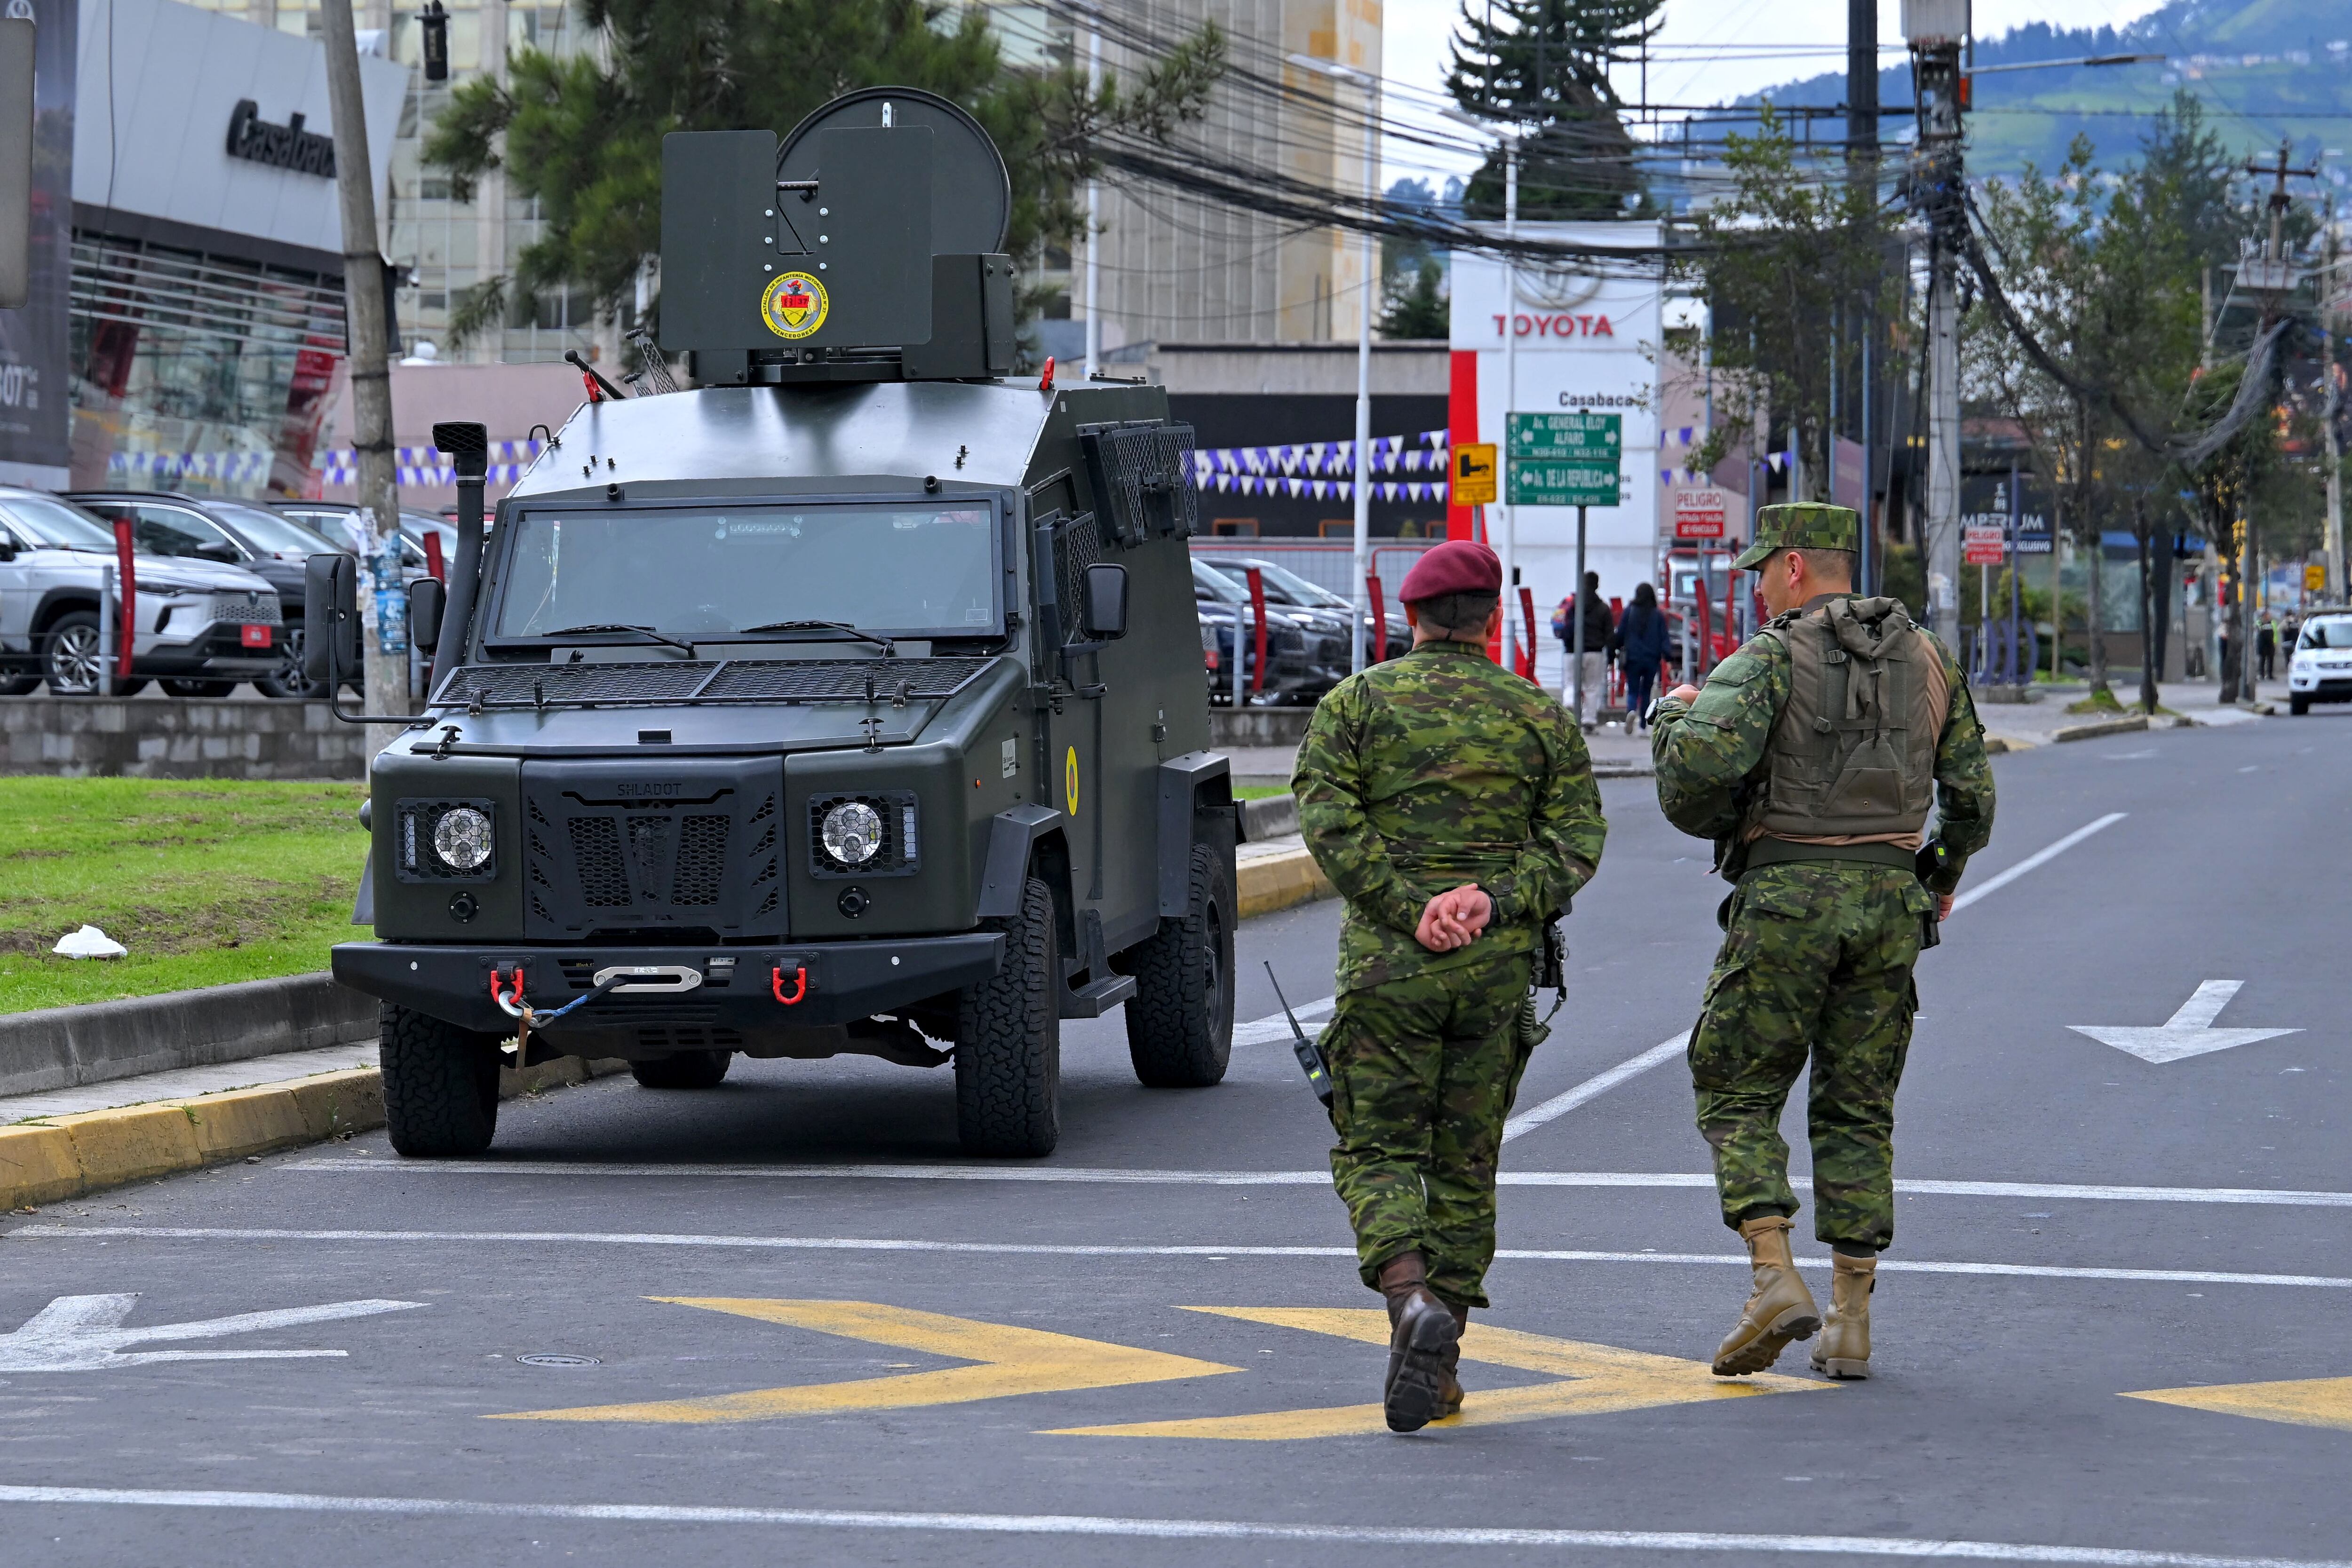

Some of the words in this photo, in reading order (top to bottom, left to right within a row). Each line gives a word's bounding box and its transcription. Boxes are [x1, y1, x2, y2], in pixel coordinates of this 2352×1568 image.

[226, 98, 337, 179] Casabac
[775, 273, 803, 284] INFANTERÍA
[805, 275, 826, 300] MOTORIZADO
[1493, 314, 1614, 336] TOYOTA
[1559, 390, 1634, 406] Casabaca
[1548, 416, 1585, 430] GENERAL
[1586, 416, 1606, 430] ELOY
[1554, 431, 1585, 445] ALFARO
[1546, 469, 1556, 488] DE
[1557, 469, 1566, 488] LA
[1677, 492, 1721, 507] PELIGRO
[1960, 512, 2044, 531] MPERIUM
[2016, 540, 2051, 552] XCLUSIVO
[618, 783, 682, 796] SHLADOT
